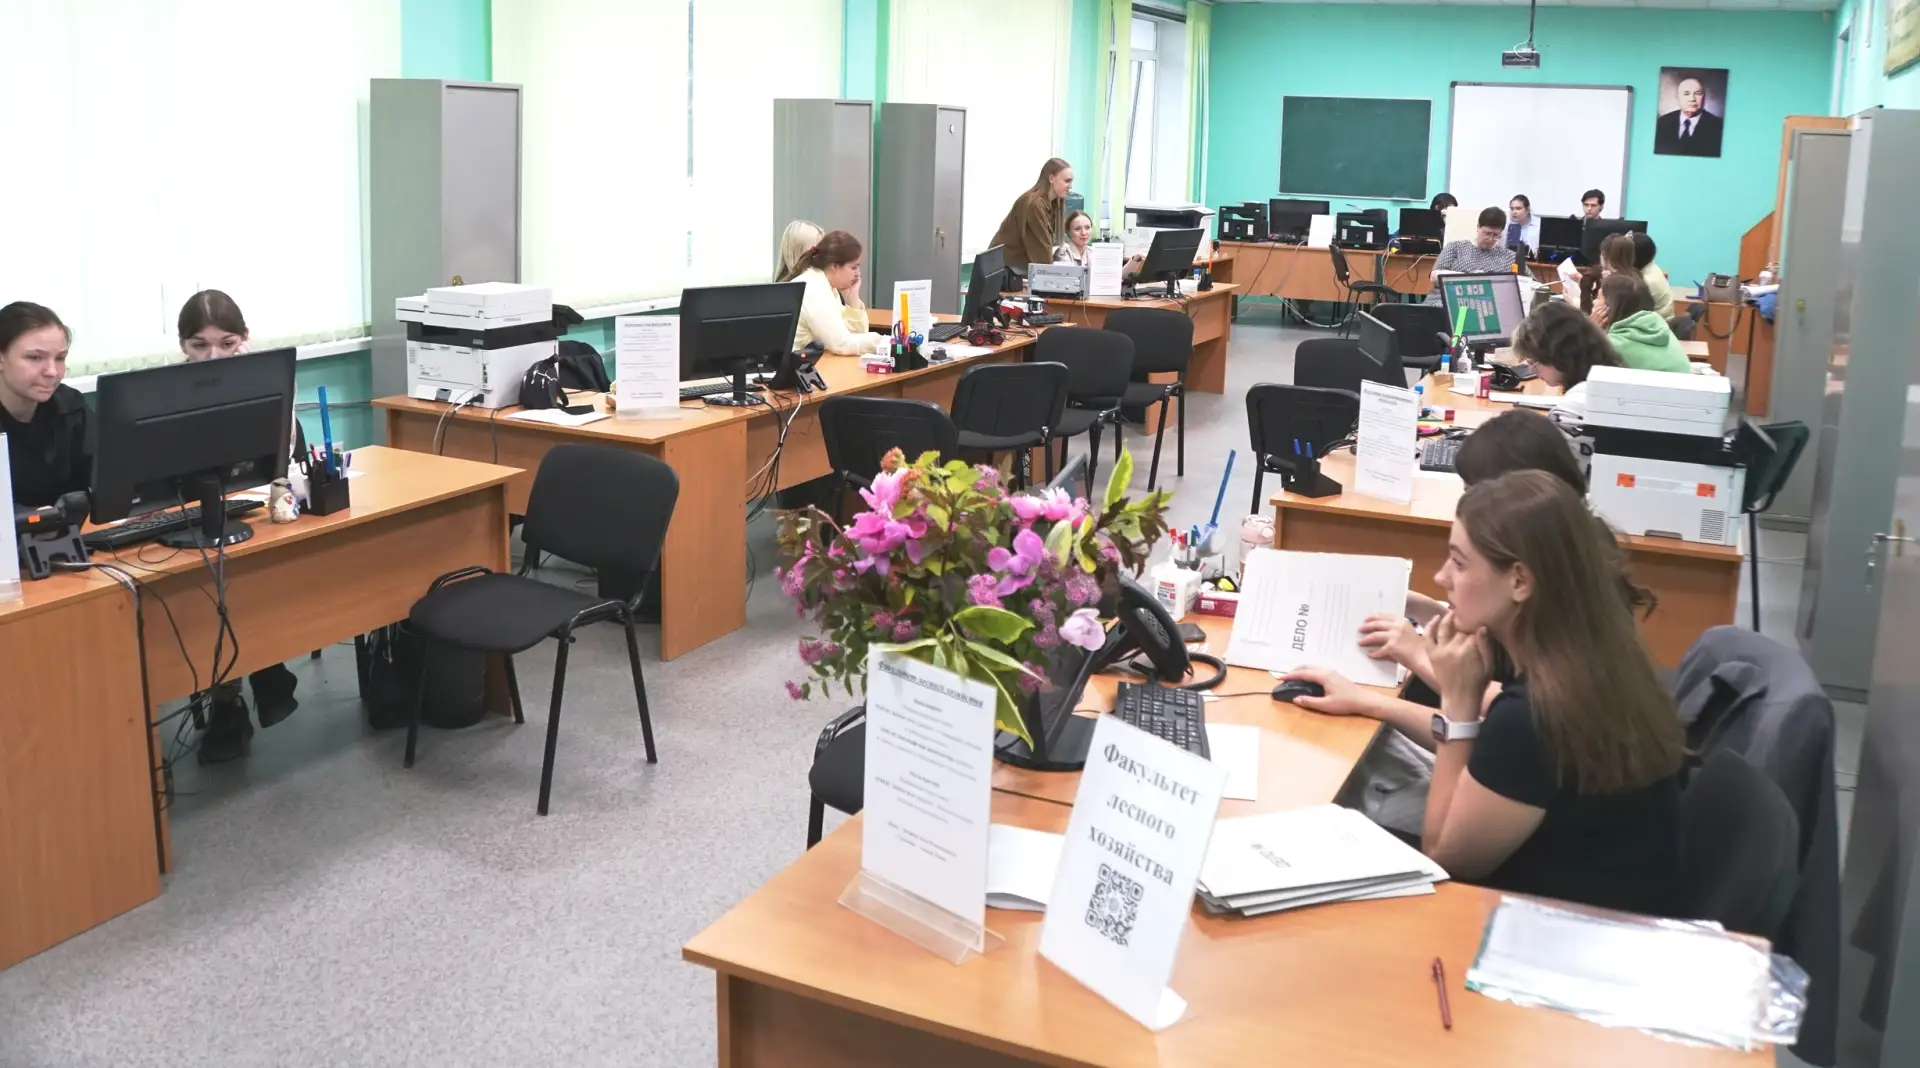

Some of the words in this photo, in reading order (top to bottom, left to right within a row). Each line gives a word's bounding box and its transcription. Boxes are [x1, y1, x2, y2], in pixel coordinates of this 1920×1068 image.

[1298, 603, 1310, 616] №
[1292, 619, 1308, 651] ДЕЛО
[1103, 743, 1200, 806] Факультет
[1106, 793, 1176, 840] лесного
[1087, 825, 1175, 886] хозяйства
